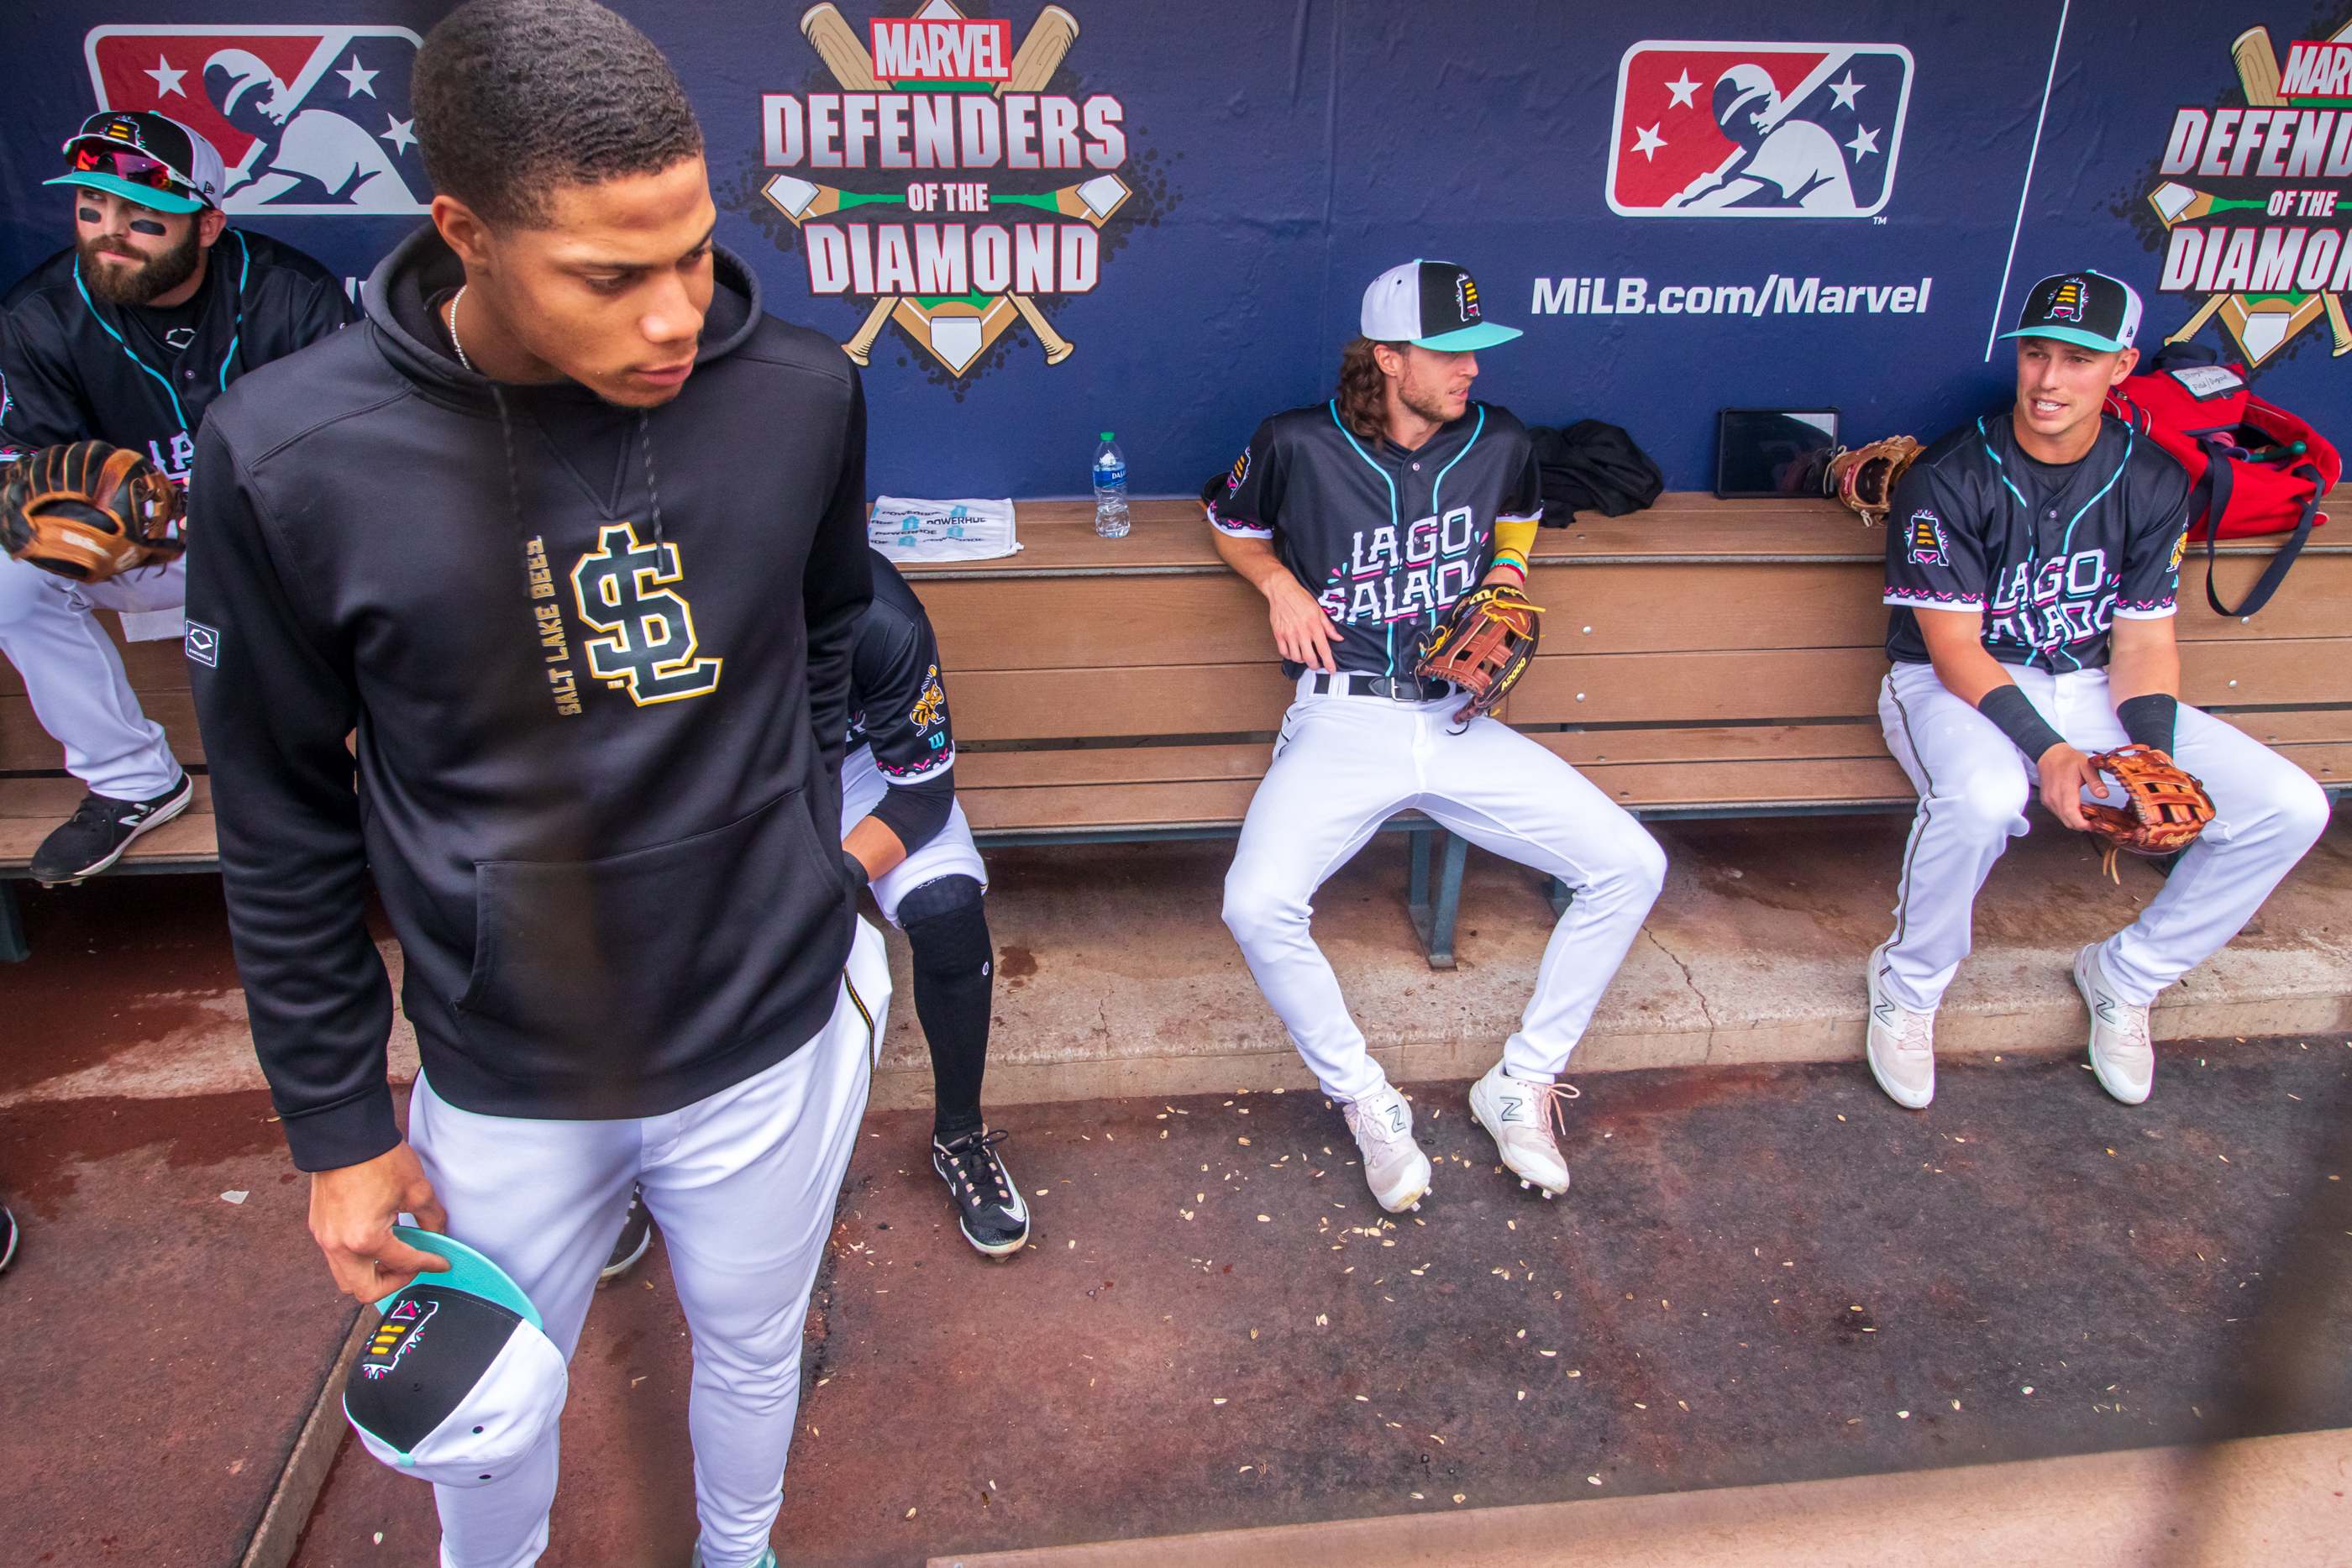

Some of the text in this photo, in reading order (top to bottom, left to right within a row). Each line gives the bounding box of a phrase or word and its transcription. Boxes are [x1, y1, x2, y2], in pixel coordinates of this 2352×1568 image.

[874, 24, 1008, 77] MARVEL
[2280, 45, 2352, 95] MAR
[762, 93, 1127, 169] DEFENDERS
[907, 183, 989, 212] OF THE
[1872, 216, 1887, 225] TM
[2266, 190, 2340, 217] OF THE
[804, 223, 1099, 294] DIAMOND
[1531, 275, 1932, 317] MiLB.com/Marvel
[1352, 506, 1473, 575] LAGO
[1318, 554, 1481, 623] SALAD
[1992, 548, 2107, 610] LAGO
[533, 604, 569, 663] LAKE
[548, 668, 583, 716] SALT
[1501, 657, 1526, 691] A2000
